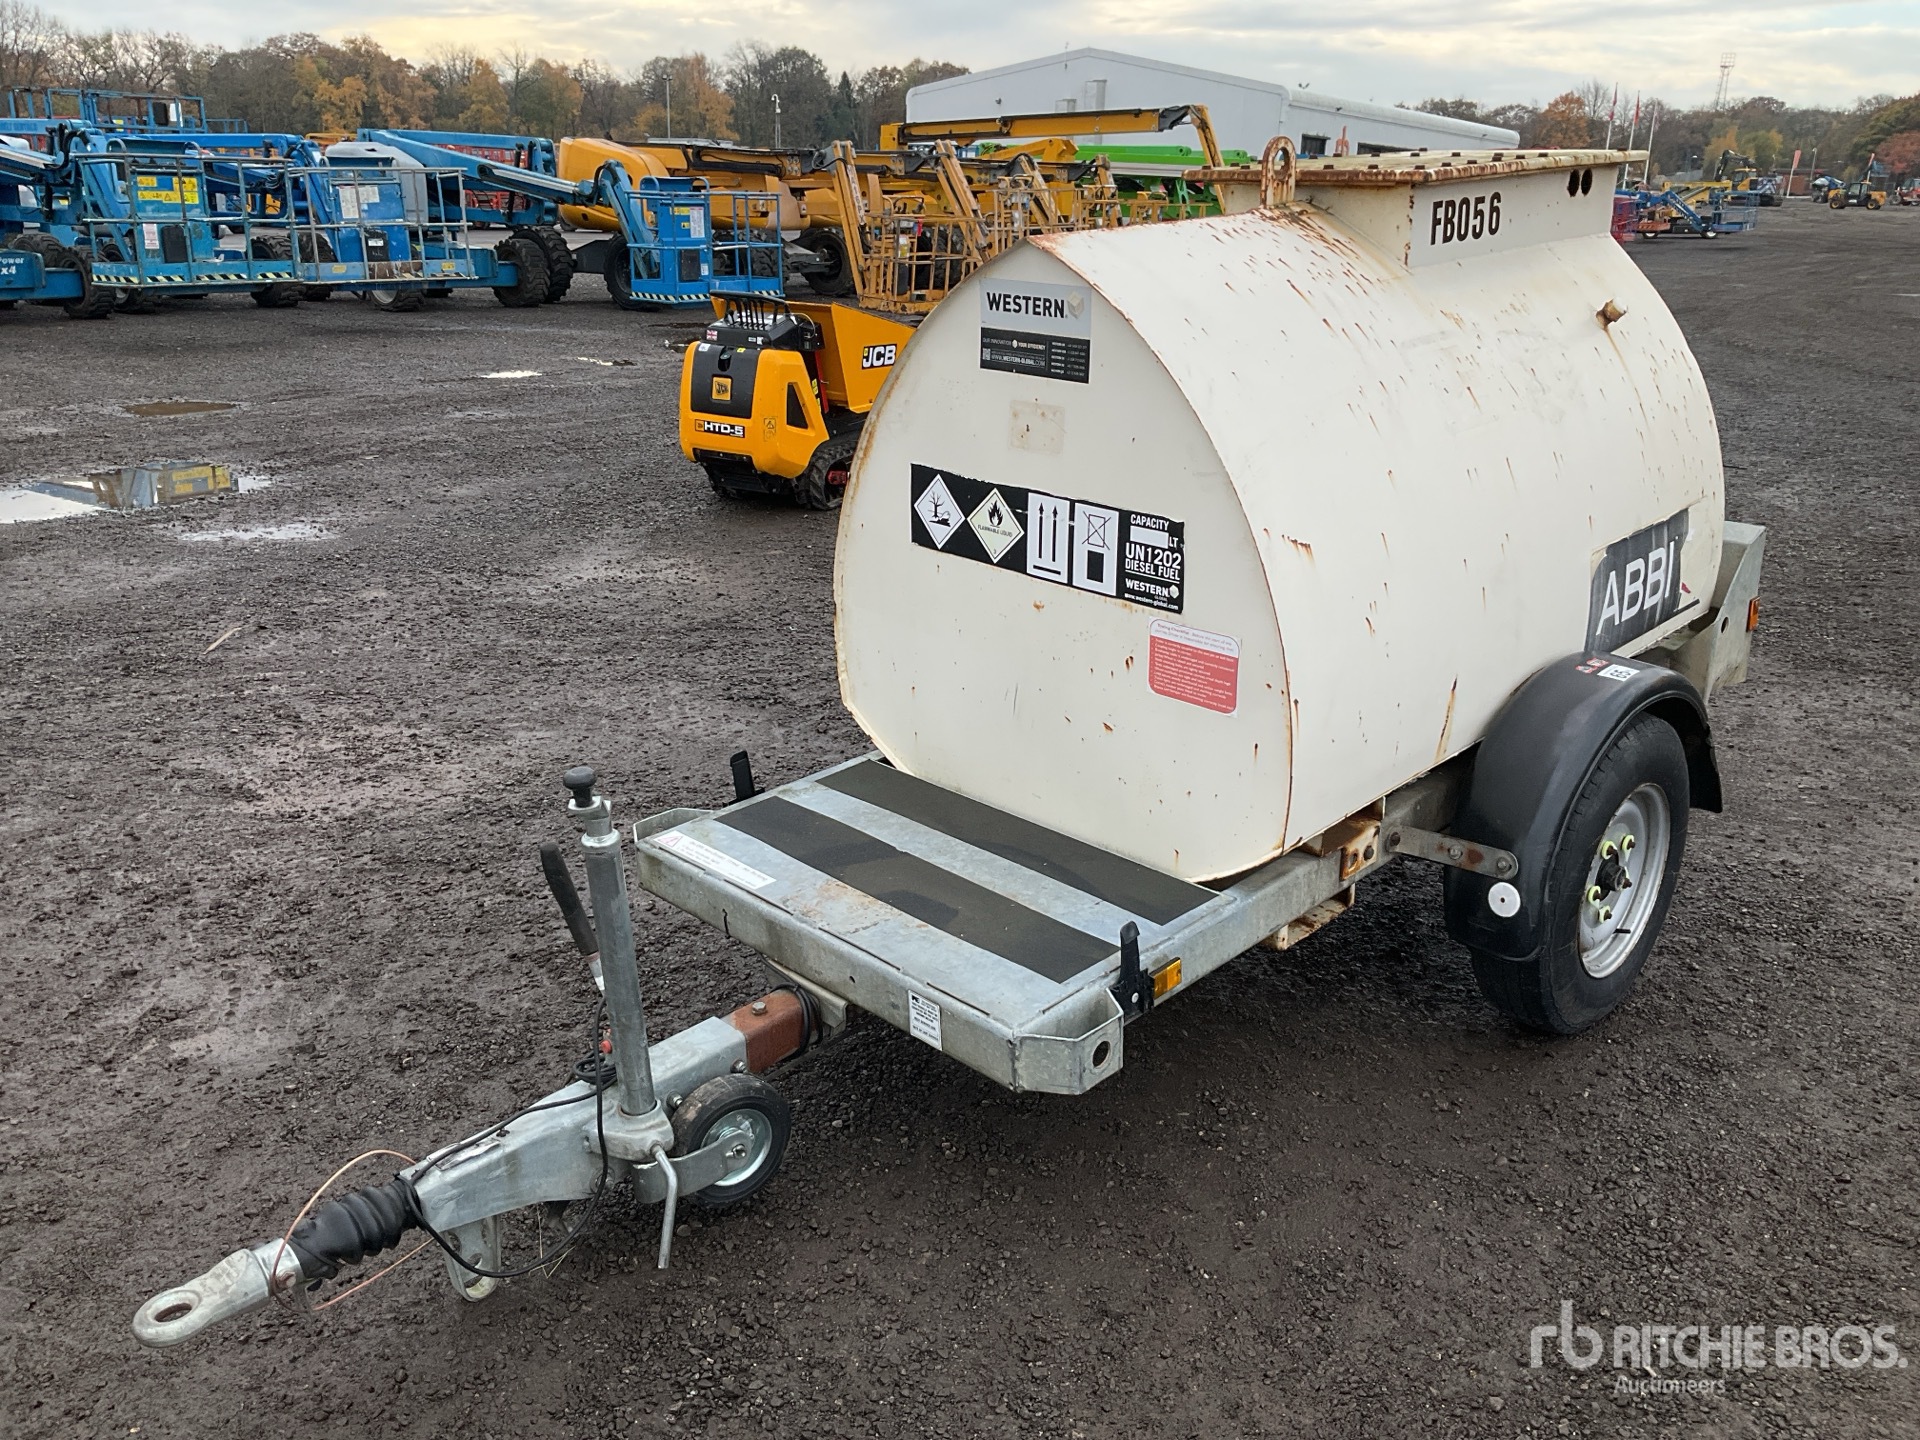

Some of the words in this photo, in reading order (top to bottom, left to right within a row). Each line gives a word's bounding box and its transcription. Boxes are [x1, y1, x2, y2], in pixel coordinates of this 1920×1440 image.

[1430, 191, 1502, 246] FB056
[0, 257, 25, 265] ower
[987, 291, 1065, 319] WESTERN
[862, 345, 896, 368] JCB
[704, 421, 744, 435] HTD-5
[1130, 513, 1170, 531] CAPACITY
[1169, 536, 1179, 548] LT
[1125, 558, 1156, 575] DIESEL
[1158, 565, 1180, 581] FUEL
[1125, 578, 1169, 597] WESTERN
